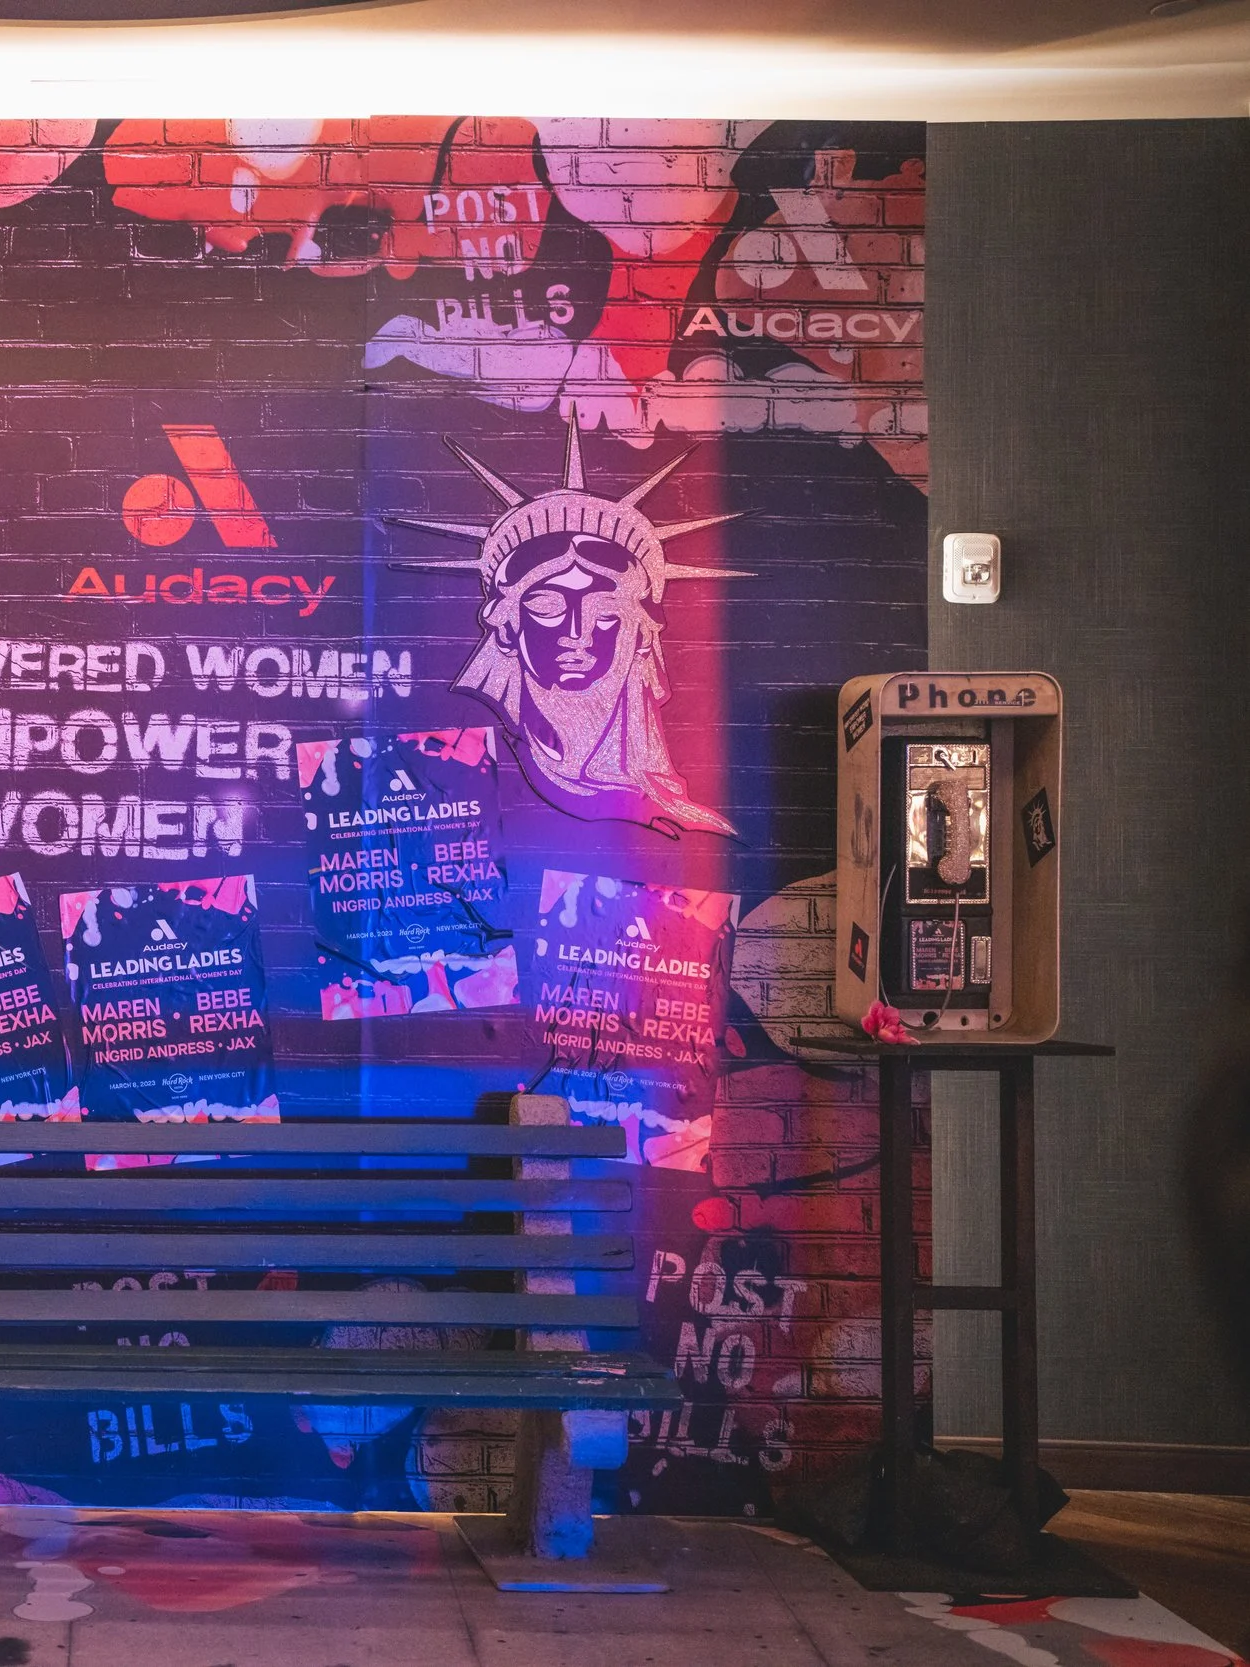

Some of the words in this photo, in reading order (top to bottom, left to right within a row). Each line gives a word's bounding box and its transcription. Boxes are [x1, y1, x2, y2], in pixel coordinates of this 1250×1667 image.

[423, 186, 544, 234] POST
[461, 234, 523, 281] NO
[683, 307, 923, 342] Audacy
[68, 567, 336, 618] Audacy
[186, 644, 413, 700] WOMEN
[898, 683, 1036, 708] Phone
[382, 792, 426, 803] Audacy
[329, 806, 410, 829] LEADING
[415, 801, 481, 821] LADIES
[331, 830, 376, 839] CELEBRATING
[378, 826, 431, 835] INTERNATIONAL
[434, 822, 466, 831] WOMEN'S
[320, 848, 398, 872] MAREN
[435, 841, 489, 862] BEBE
[320, 870, 404, 894] MORRIS
[427, 862, 502, 884] REXHA
[332, 899, 381, 913] INGRID
[385, 892, 452, 908] ANDRESS
[463, 889, 494, 902] JAX
[143, 942, 188, 952] Audacy
[615, 939, 660, 952] Audacy
[14, 967, 27, 976] DAY
[90, 956, 171, 979] LEADING
[176, 949, 243, 969] LADIES
[558, 944, 640, 969] LEADING
[644, 956, 711, 979] LADIES
[92, 980, 138, 989] CELEBRATING
[140, 975, 194, 985] INTERNATIONAL
[196, 971, 228, 979] WOMEN'S
[557, 965, 603, 976] CELEBRATING
[604, 972, 658, 984] INTERNATIONAL
[660, 978, 692, 989] WOMEN'S
[694, 983, 708, 991] DAY
[196, 988, 252, 1010] BEBE
[541, 983, 619, 1010] MAREN
[82, 998, 161, 1024] MAREN
[190, 1009, 264, 1033] REXHA
[535, 1004, 619, 1032] MORRIS
[656, 999, 711, 1023] BEBE
[23, 1031, 53, 1048] JAX
[82, 1020, 167, 1044] MORRIS
[643, 1019, 716, 1046] REXHA
[95, 1050, 143, 1064] INGRID
[148, 1041, 214, 1059] ANDRESS
[227, 1036, 256, 1050] JAX
[543, 1032, 591, 1049] INGRID
[595, 1040, 662, 1059] ANDRESS
[674, 1050, 705, 1065] JAX
[646, 1250, 808, 1333] POST
[674, 1321, 756, 1389] NO
[87, 1403, 253, 1463] BILLS
